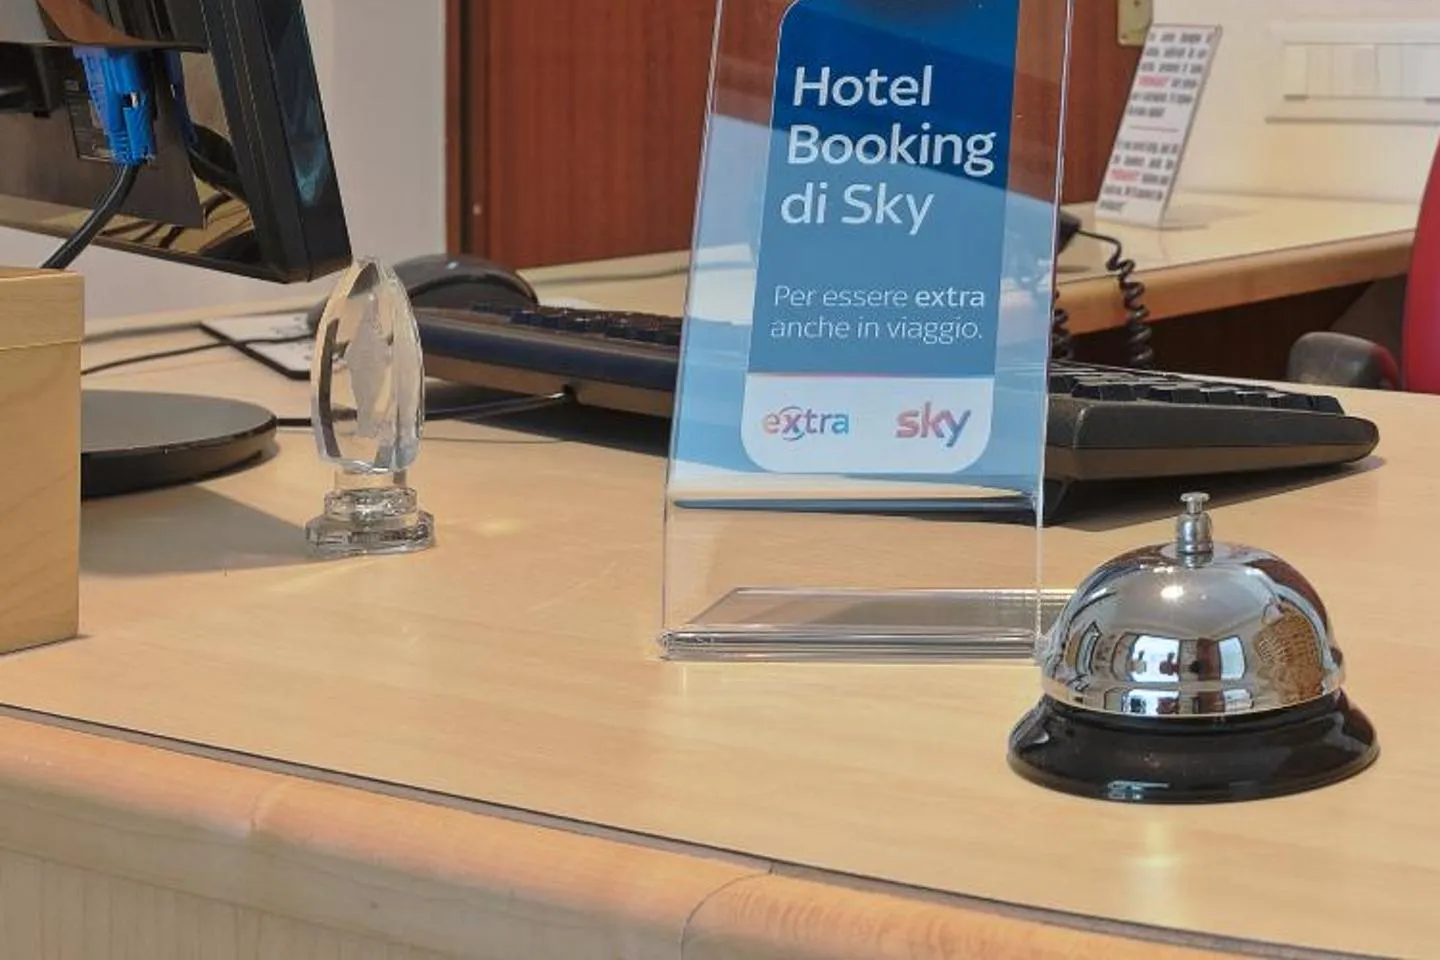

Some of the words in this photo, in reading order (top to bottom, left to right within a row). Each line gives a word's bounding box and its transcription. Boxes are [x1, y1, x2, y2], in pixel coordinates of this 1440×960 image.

[793, 65, 933, 107] Hotel
[787, 122, 996, 177] Booking
[781, 182, 828, 225] di
[841, 184, 934, 235] Sky
[773, 285, 816, 307] Per
[822, 290, 908, 308] essere
[915, 287, 984, 308] extra
[771, 316, 849, 339] anche
[857, 317, 879, 339] in
[888, 317, 983, 344] viaggio.
[762, 408, 849, 436] extra
[895, 401, 972, 447] sky
